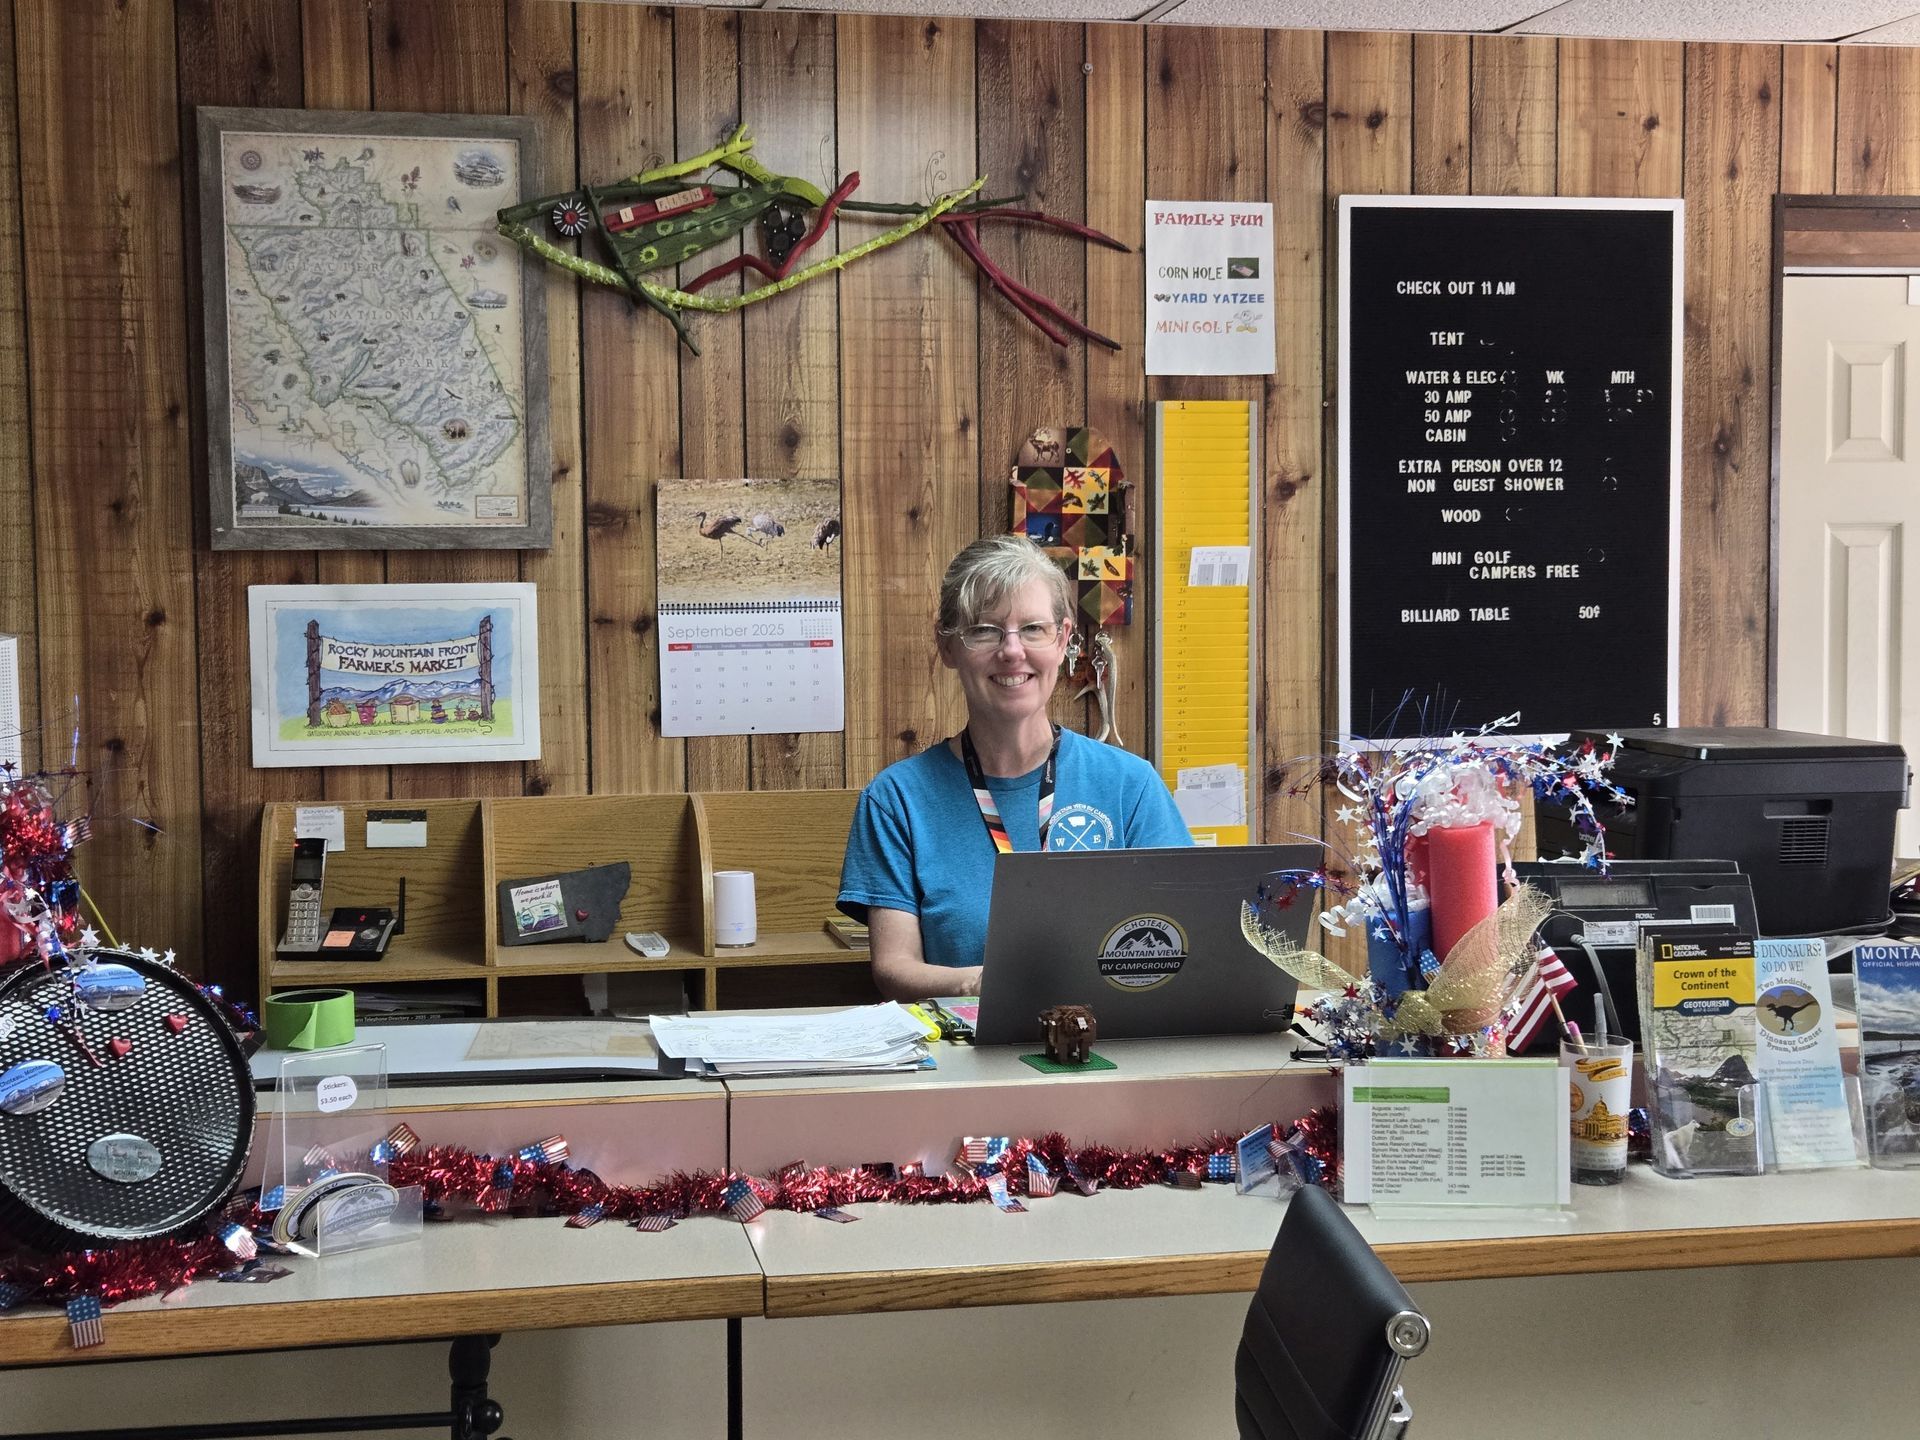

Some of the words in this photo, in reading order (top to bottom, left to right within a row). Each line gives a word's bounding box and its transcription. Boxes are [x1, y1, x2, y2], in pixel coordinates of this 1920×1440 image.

[1154, 212, 1225, 226] FAMILY
[1230, 214, 1264, 227] FUN
[287, 262, 380, 272] GLACIER
[1158, 266, 1189, 280] CORN
[1192, 267, 1223, 280] HOLE
[1396, 282, 1441, 295] CHECK
[1448, 282, 1475, 295] OUT
[1481, 282, 1492, 295] 11
[1496, 282, 1516, 295] AM
[1172, 293, 1208, 304] YARD
[1213, 293, 1265, 304] YATZEE
[329, 310, 439, 321] NATIONAL
[1155, 320, 1189, 334] MINI
[1192, 320, 1234, 334] GOLF
[1430, 332, 1464, 346] TENT
[399, 358, 449, 368] PARK
[1406, 371, 1449, 384] WATER
[1452, 371, 1461, 384] &
[1466, 371, 1497, 384] ELEC
[1546, 371, 1564, 384] WK
[1611, 371, 1635, 384] MTH
[1424, 391, 1440, 404] 30
[1445, 390, 1472, 404] AMP
[1424, 410, 1440, 423] 50
[1445, 409, 1472, 423] AMP
[1425, 429, 1466, 442] CABIN
[1399, 460, 1441, 474] EXTRA
[1451, 459, 1501, 473] PERSON
[1508, 459, 1543, 472] OVER
[1549, 458, 1563, 472] 12
[1407, 479, 1436, 493] NON
[1453, 478, 1495, 492] GUEST
[1504, 478, 1564, 492] SHOWER
[1441, 509, 1482, 523] WOOD
[1431, 552, 1462, 566] MINI
[1474, 551, 1512, 565] GOLF
[1469, 565, 1537, 580] CAMPERS
[1546, 565, 1580, 579] FREE
[1401, 608, 1460, 623] BILLIARD
[1469, 607, 1510, 622] TABLE
[667, 625, 748, 641] September
[752, 623, 785, 637] 2025
[328, 643, 369, 658] ROCKY
[373, 647, 434, 658] MOUNTAIN
[438, 643, 477, 654] FRONT
[339, 656, 405, 674] FARMER'S
[410, 655, 467, 673] MARKET
[1652, 713, 1661, 726] 5
[1055, 838, 1065, 847] W
[1093, 835, 1101, 844] E
[515, 889, 534, 897] Home
[540, 883, 560, 892] where
[529, 892, 545, 904] park
[1124, 919, 1169, 932] CHOTEAU
[1105, 950, 1155, 958] MOUNTAIN
[1157, 949, 1180, 957] VIEW
[1761, 943, 1822, 958] DINOSAURS?
[1101, 963, 1114, 971] RV
[1115, 961, 1181, 970] CAMPGROUND
[1762, 962, 1773, 973] SO
[1774, 961, 1786, 972] DO
[1789, 961, 1804, 972] WE!
[1673, 970, 1705, 979] Crown
[1708, 968, 1718, 978] of
[1721, 968, 1737, 977] the
[1681, 980, 1729, 991] Continent
[1776, 976, 1812, 991] Medicine
[1683, 999, 1730, 1009] GEOTOURISM
[1759, 1028, 1796, 1046] Dinosaur
[1798, 1027, 1823, 1045] Center
